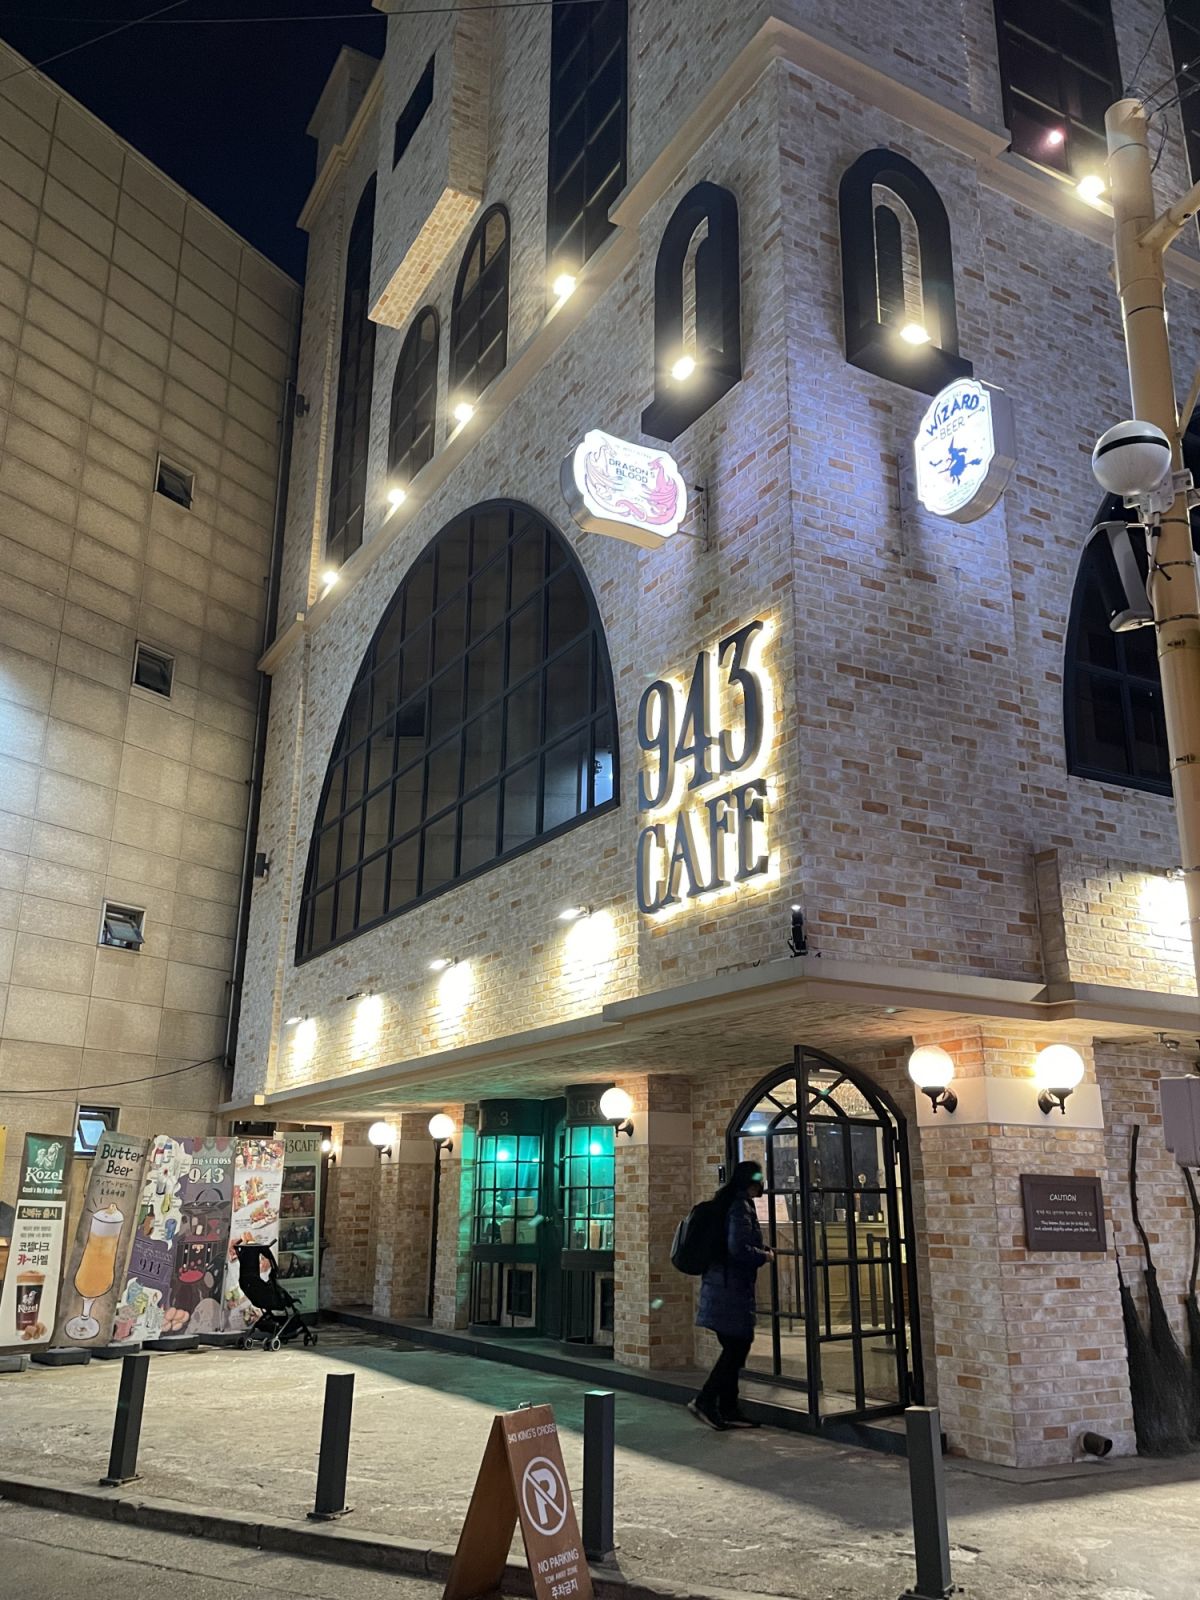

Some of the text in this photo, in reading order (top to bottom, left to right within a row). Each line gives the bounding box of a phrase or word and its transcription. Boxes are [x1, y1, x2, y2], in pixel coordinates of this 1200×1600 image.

[926, 393, 980, 436] WIZARD
[939, 416, 966, 441] BEER
[615, 467, 649, 484] BLOOD
[638, 619, 764, 811] 943
[636, 778, 769, 915] CAFE
[499, 1111, 510, 1127] 3
[101, 1143, 145, 1163] Butter
[25, 1166, 64, 1184] Kozel
[106, 1160, 134, 1177] Beer
[188, 1166, 225, 1184] 943
[1049, 1193, 1077, 1201] CAUTION
[18, 1241, 50, 1253] 코젤다크
[537, 1547, 579, 1575] NO PARKING
[551, 1577, 579, 1600] 주차금지
